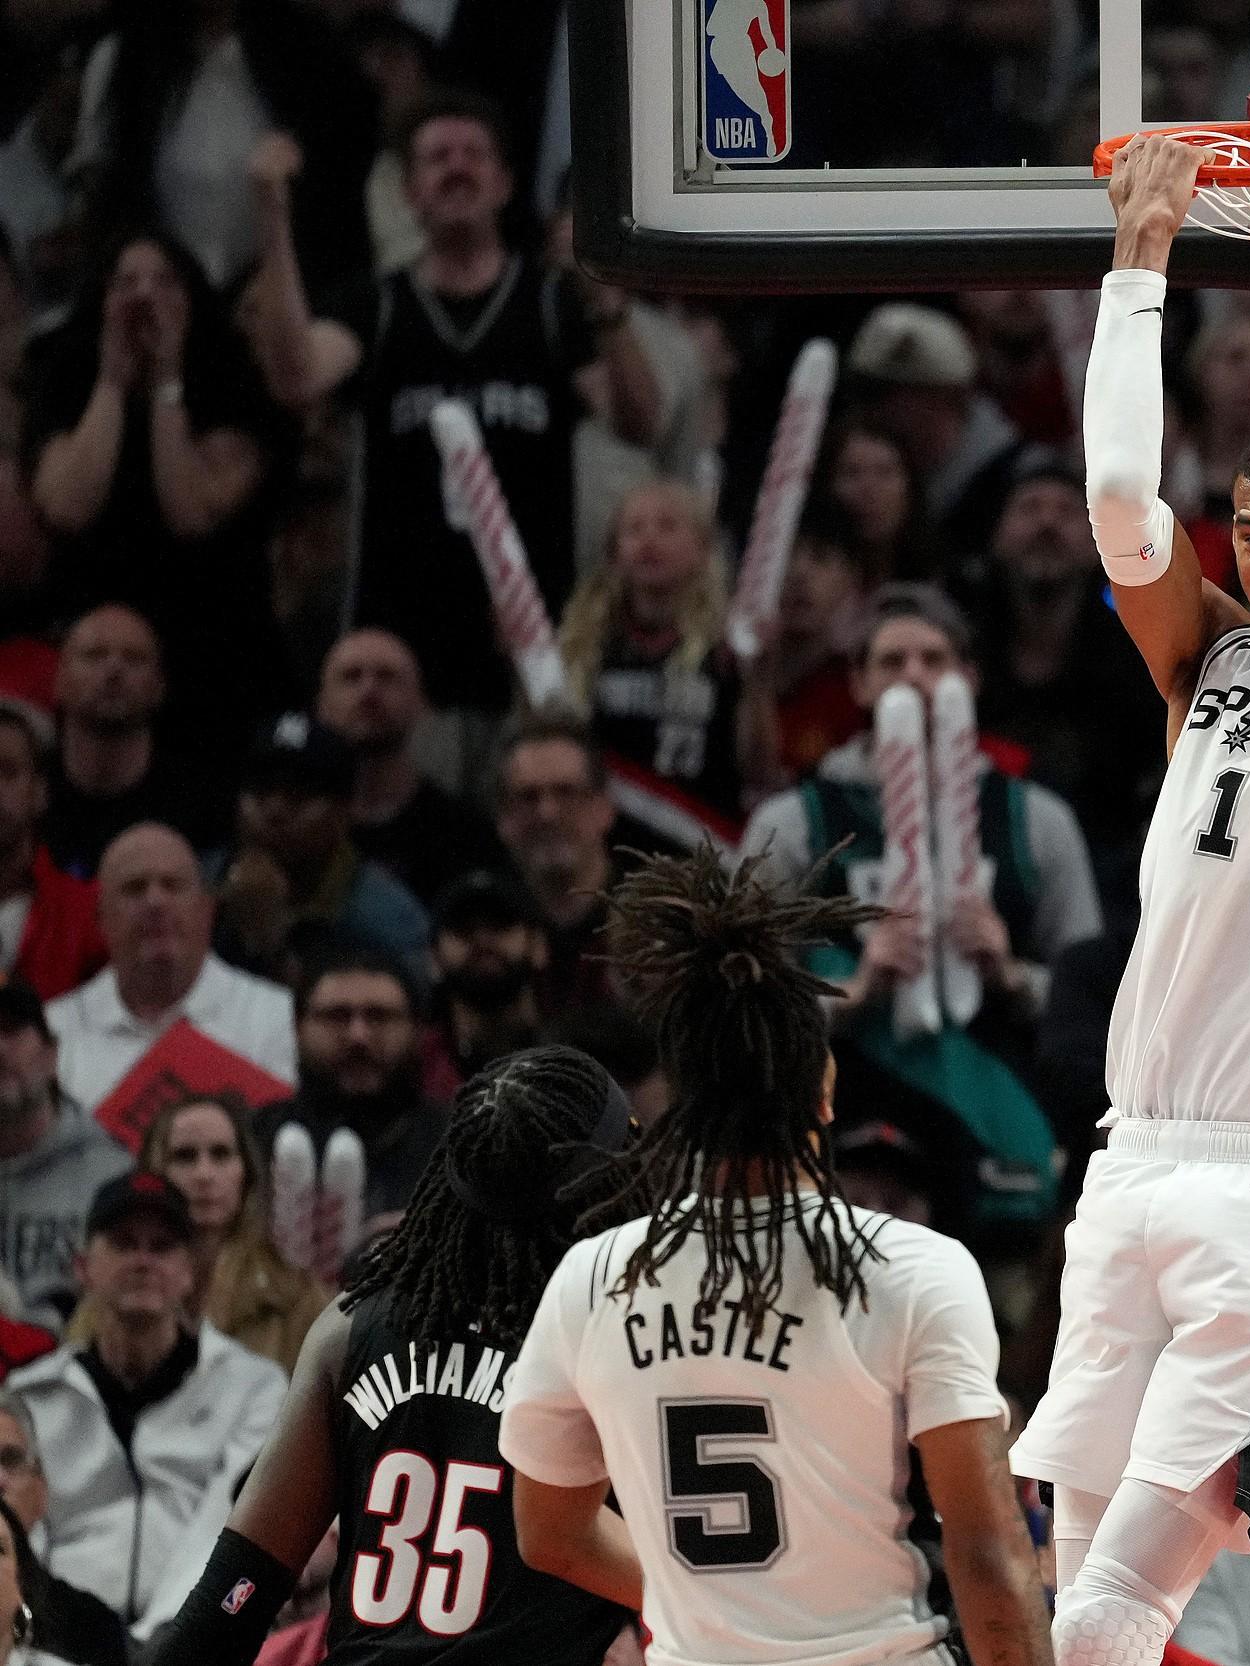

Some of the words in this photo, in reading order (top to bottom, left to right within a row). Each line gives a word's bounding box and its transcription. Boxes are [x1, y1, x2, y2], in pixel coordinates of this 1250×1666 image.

[715, 117, 756, 149] NBA
[1192, 766, 1250, 862] 1
[625, 1300, 803, 1373] CASTLE
[657, 1396, 788, 1575] 5
[351, 1448, 504, 1638] 35
